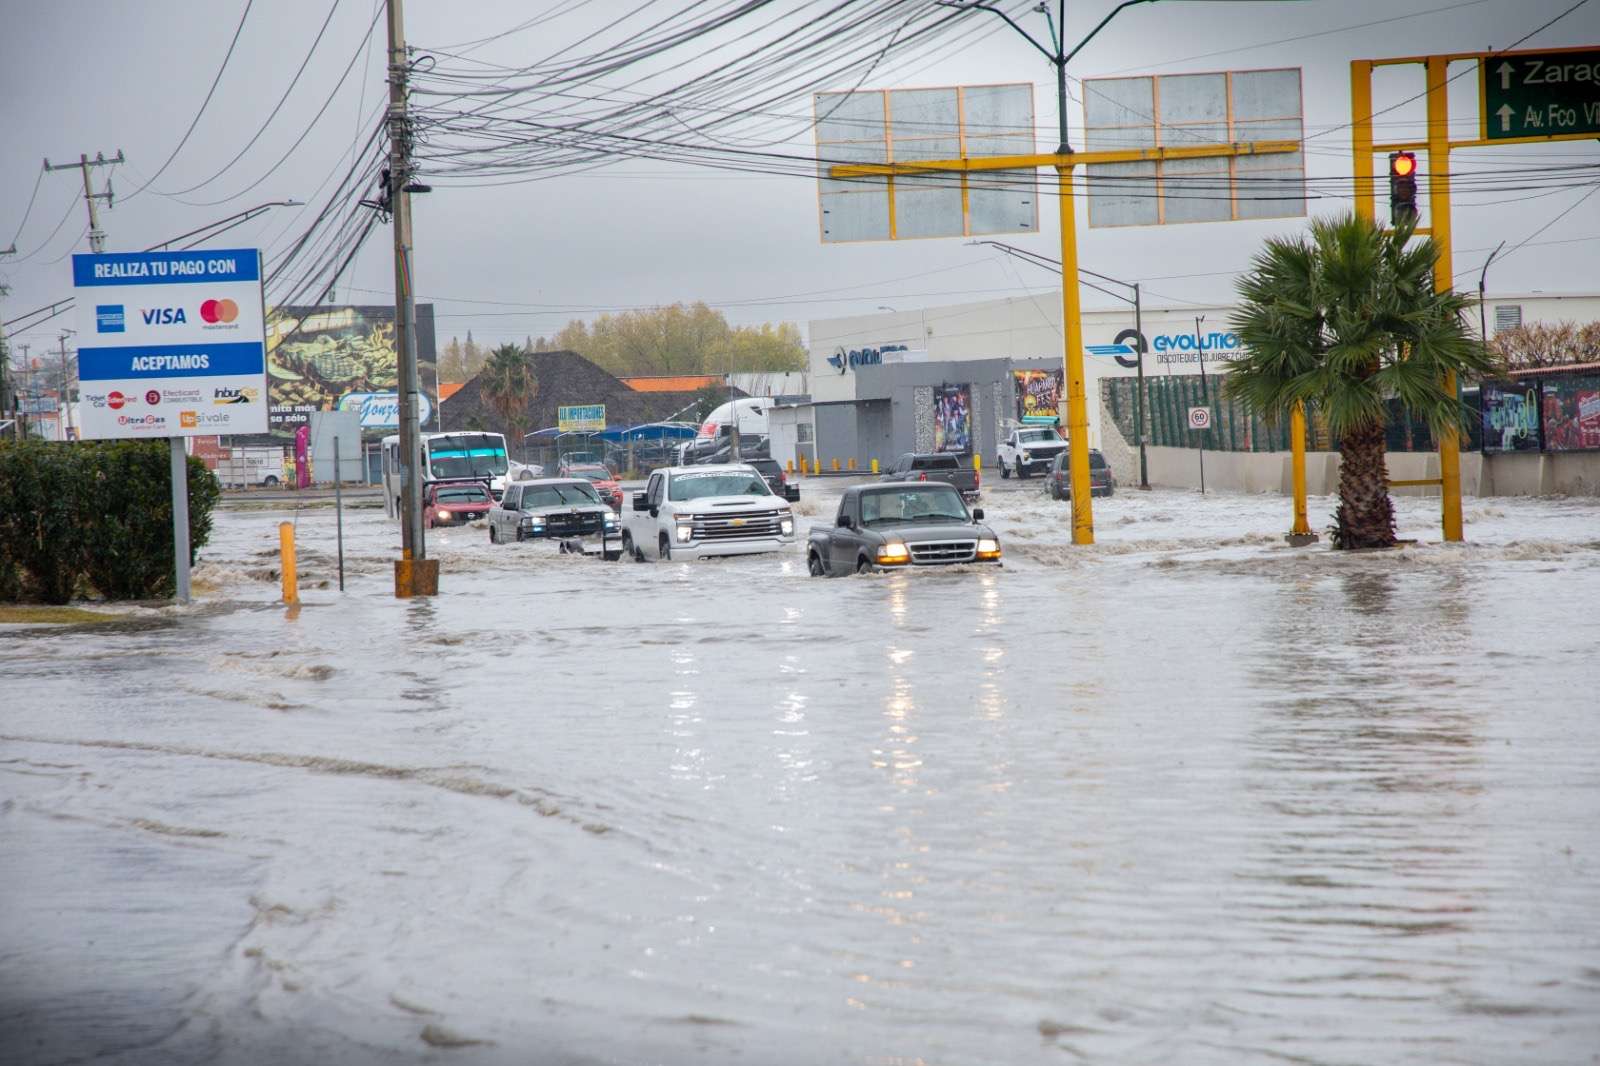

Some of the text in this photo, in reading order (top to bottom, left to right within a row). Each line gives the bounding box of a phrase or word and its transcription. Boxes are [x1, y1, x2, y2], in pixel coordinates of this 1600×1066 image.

[1523, 105, 1545, 128] Av.
[1548, 103, 1576, 127] Fco
[94, 259, 236, 278] REALIZA TU PAGO CON
[141, 308, 187, 325] VISA
[131, 354, 209, 371] ACEPTAMOS
[1194, 413, 1205, 421] 60
